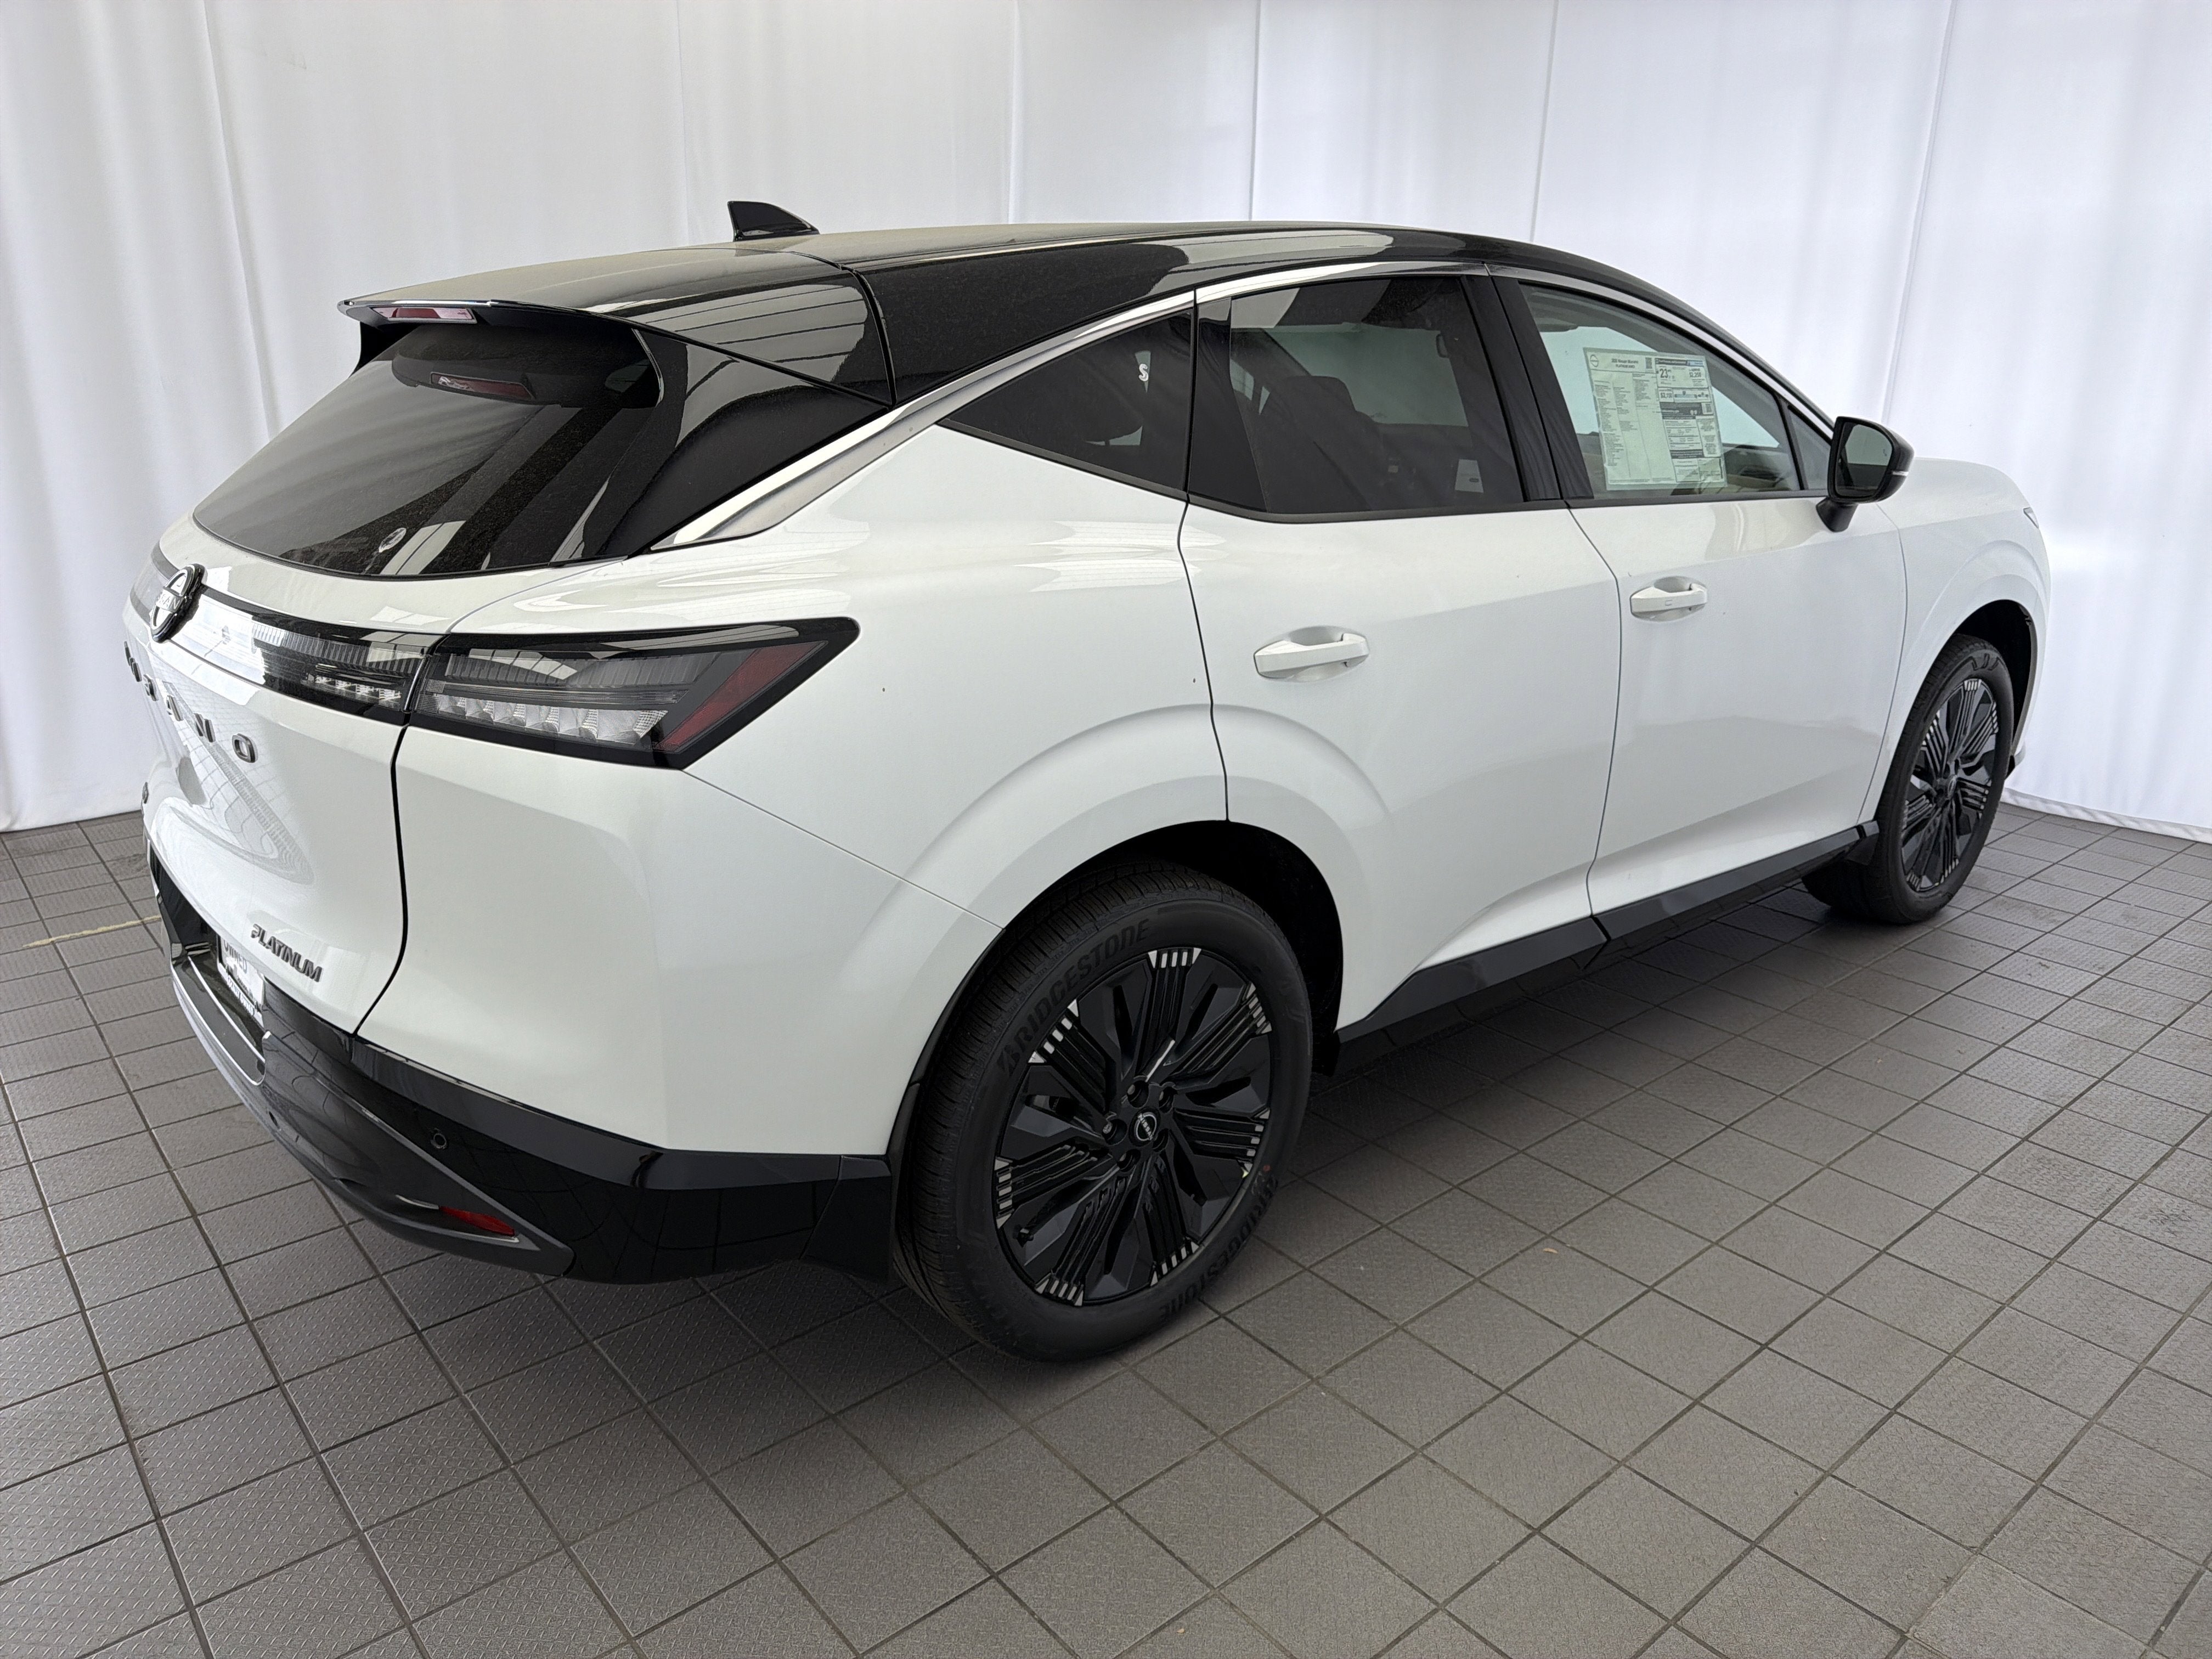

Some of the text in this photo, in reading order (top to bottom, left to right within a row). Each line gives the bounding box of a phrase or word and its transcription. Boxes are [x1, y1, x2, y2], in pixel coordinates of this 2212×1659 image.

[251, 923, 323, 983] PLATINUM
[997, 918, 1150, 1077] BRIDGESTONE
[1138, 1113, 1154, 1141] NISSAN
